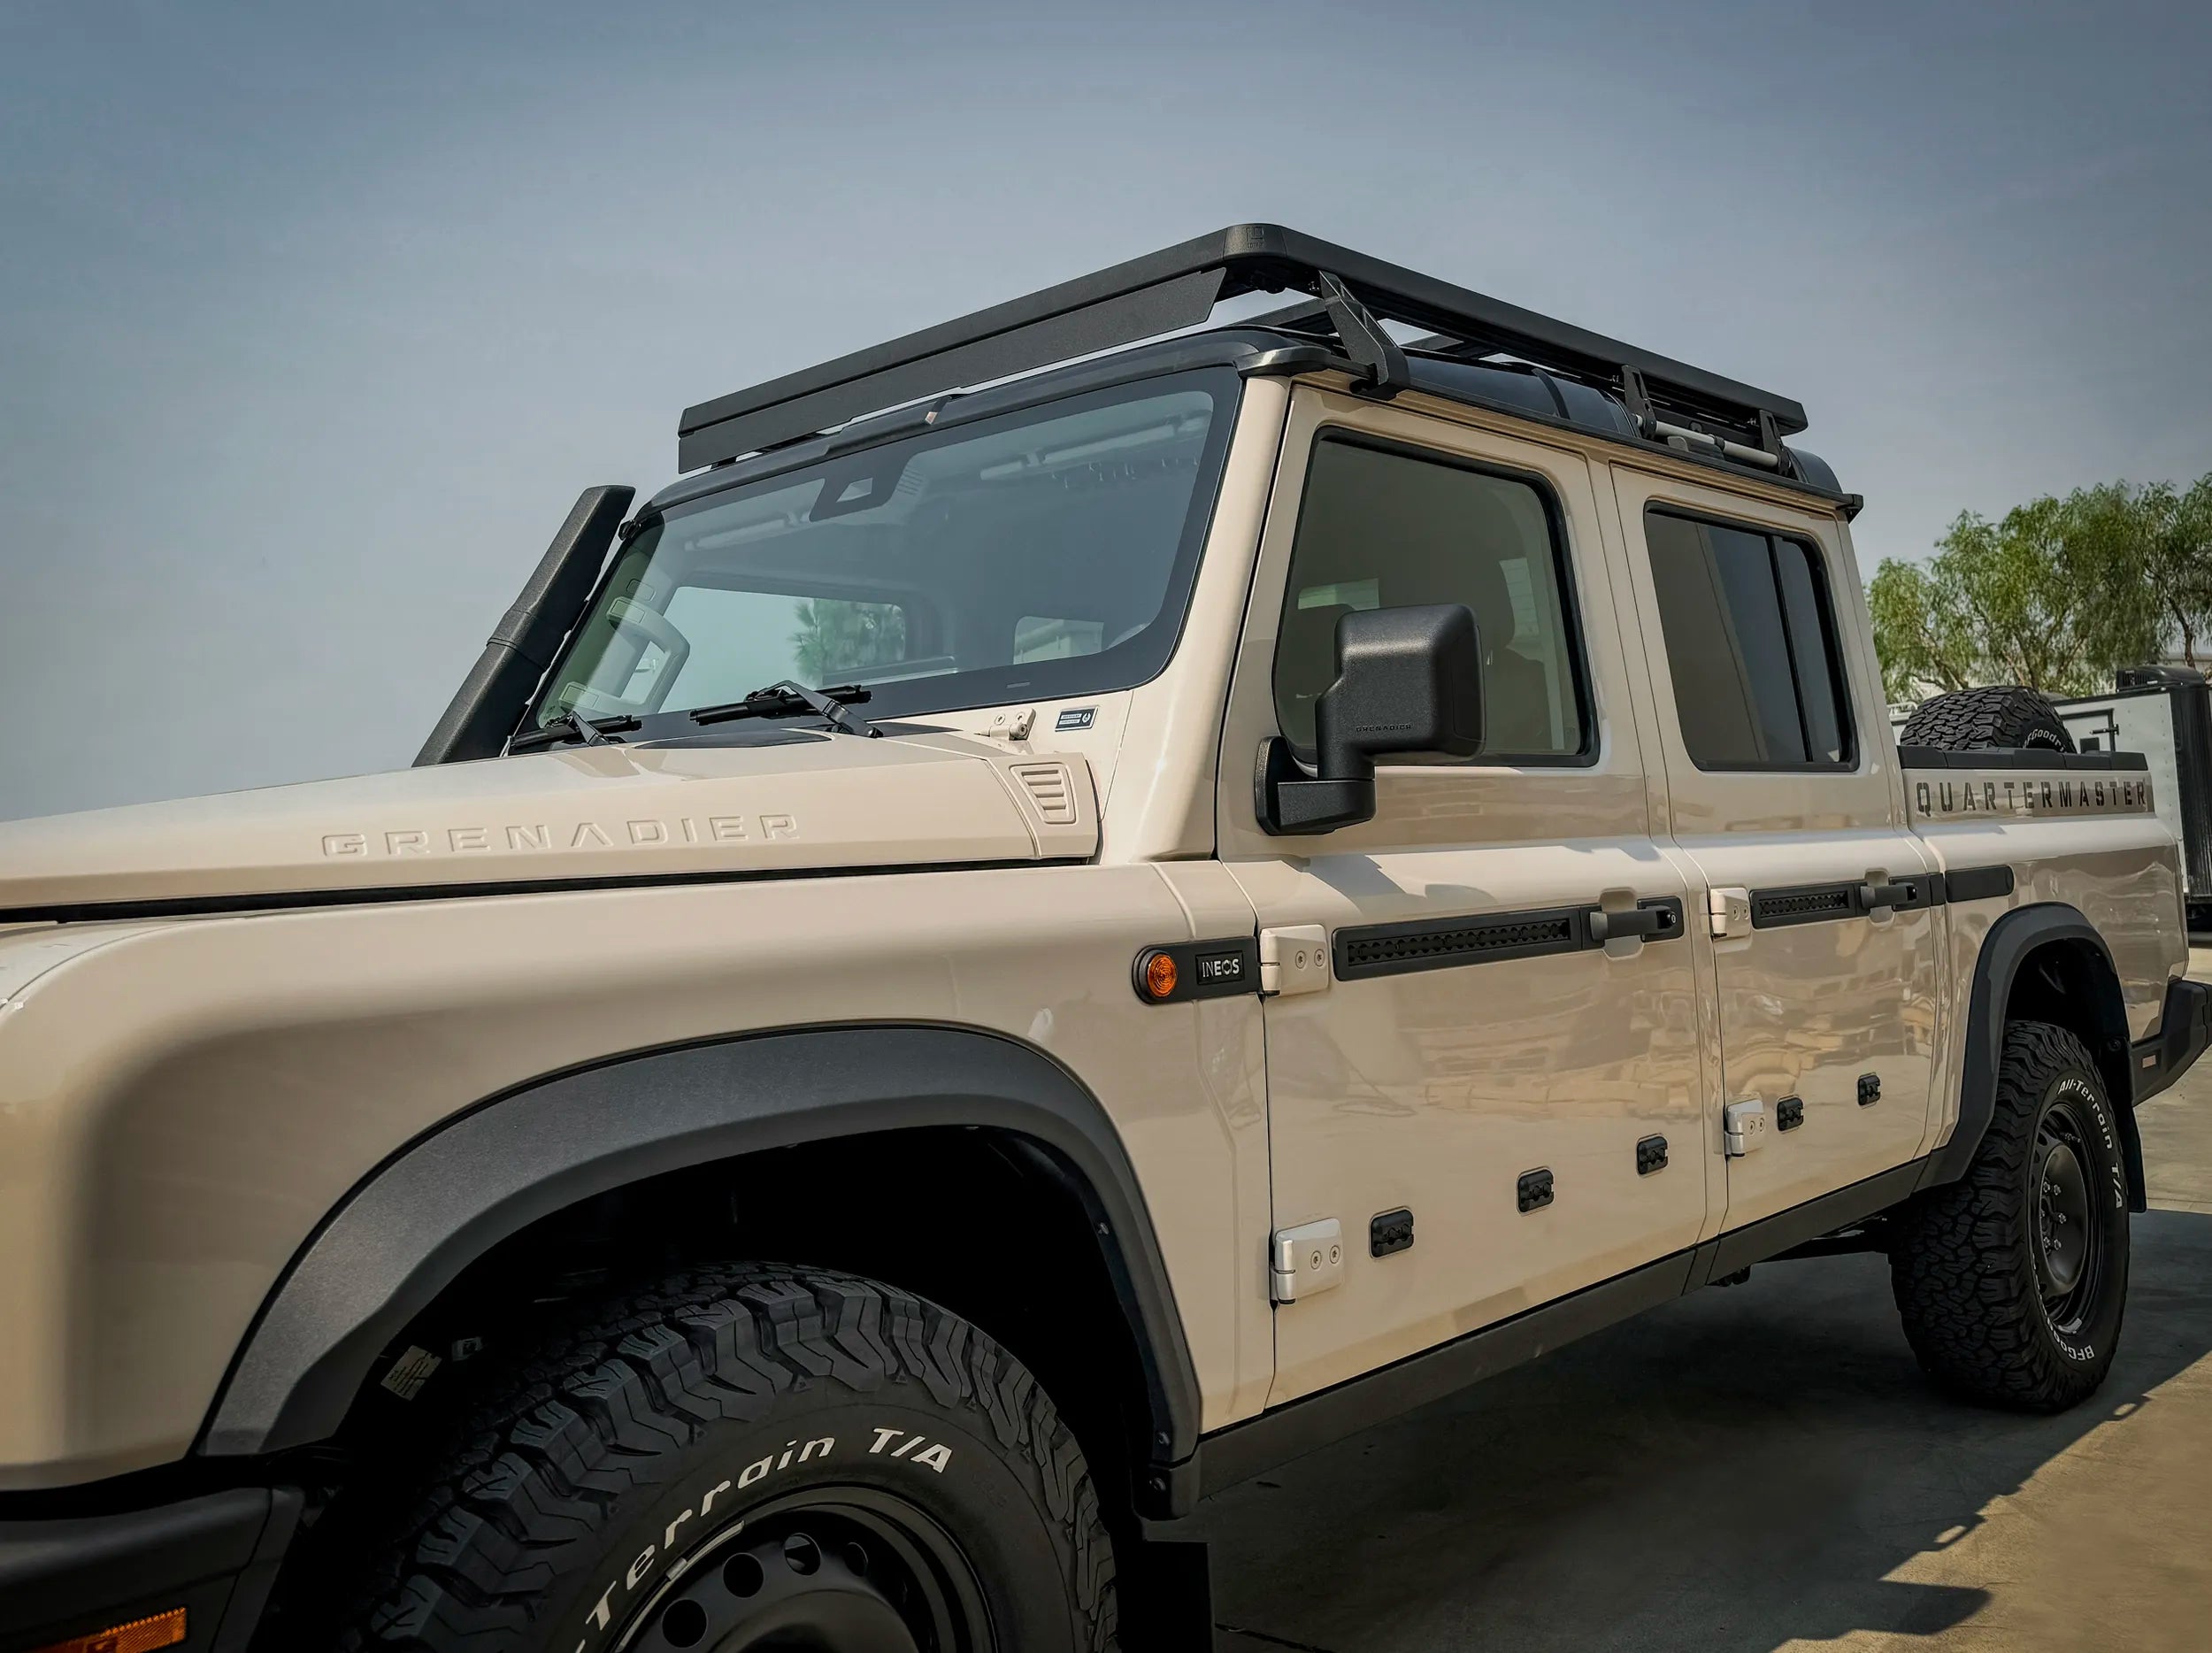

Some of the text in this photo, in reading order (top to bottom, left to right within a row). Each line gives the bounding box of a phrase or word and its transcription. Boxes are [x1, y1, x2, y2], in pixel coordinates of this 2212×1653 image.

[1356, 724, 1411, 733] GRENADIER
[1916, 781, 2146, 817] QUARTERMASTER
[321, 814, 800, 857] GRENADIER
[1202, 958, 1240, 978] INEOS
[2111, 1162, 2123, 1209] T/A
[868, 1427, 953, 1473] T/A
